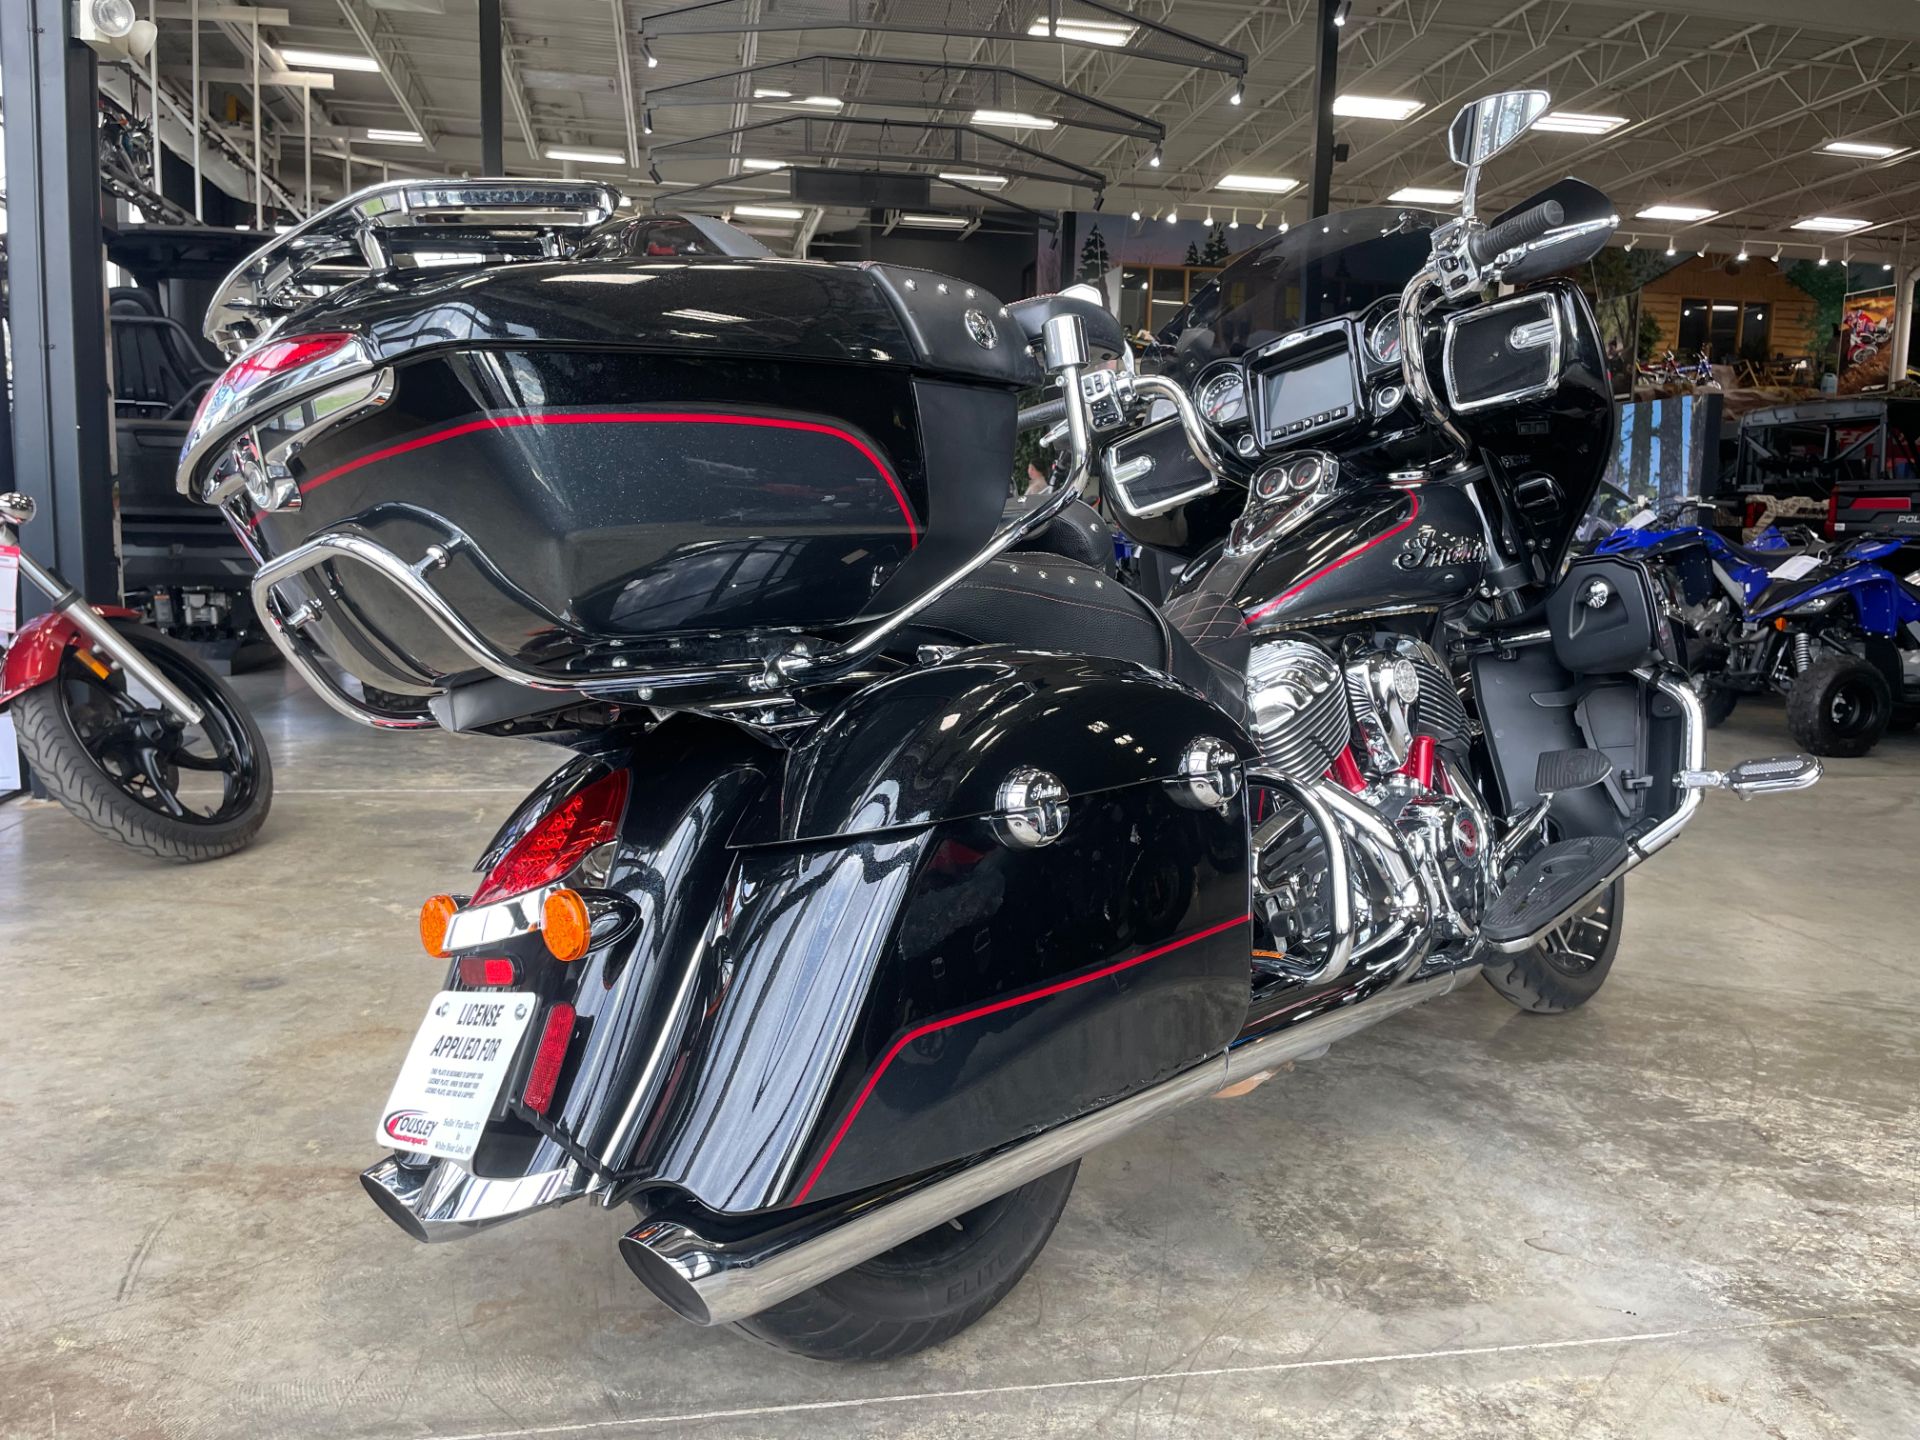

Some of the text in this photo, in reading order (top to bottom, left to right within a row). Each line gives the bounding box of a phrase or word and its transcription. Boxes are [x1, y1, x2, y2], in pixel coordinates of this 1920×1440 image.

[456, 1003, 505, 1027] LICENSE
[430, 1035, 502, 1062] APPLIED FOR
